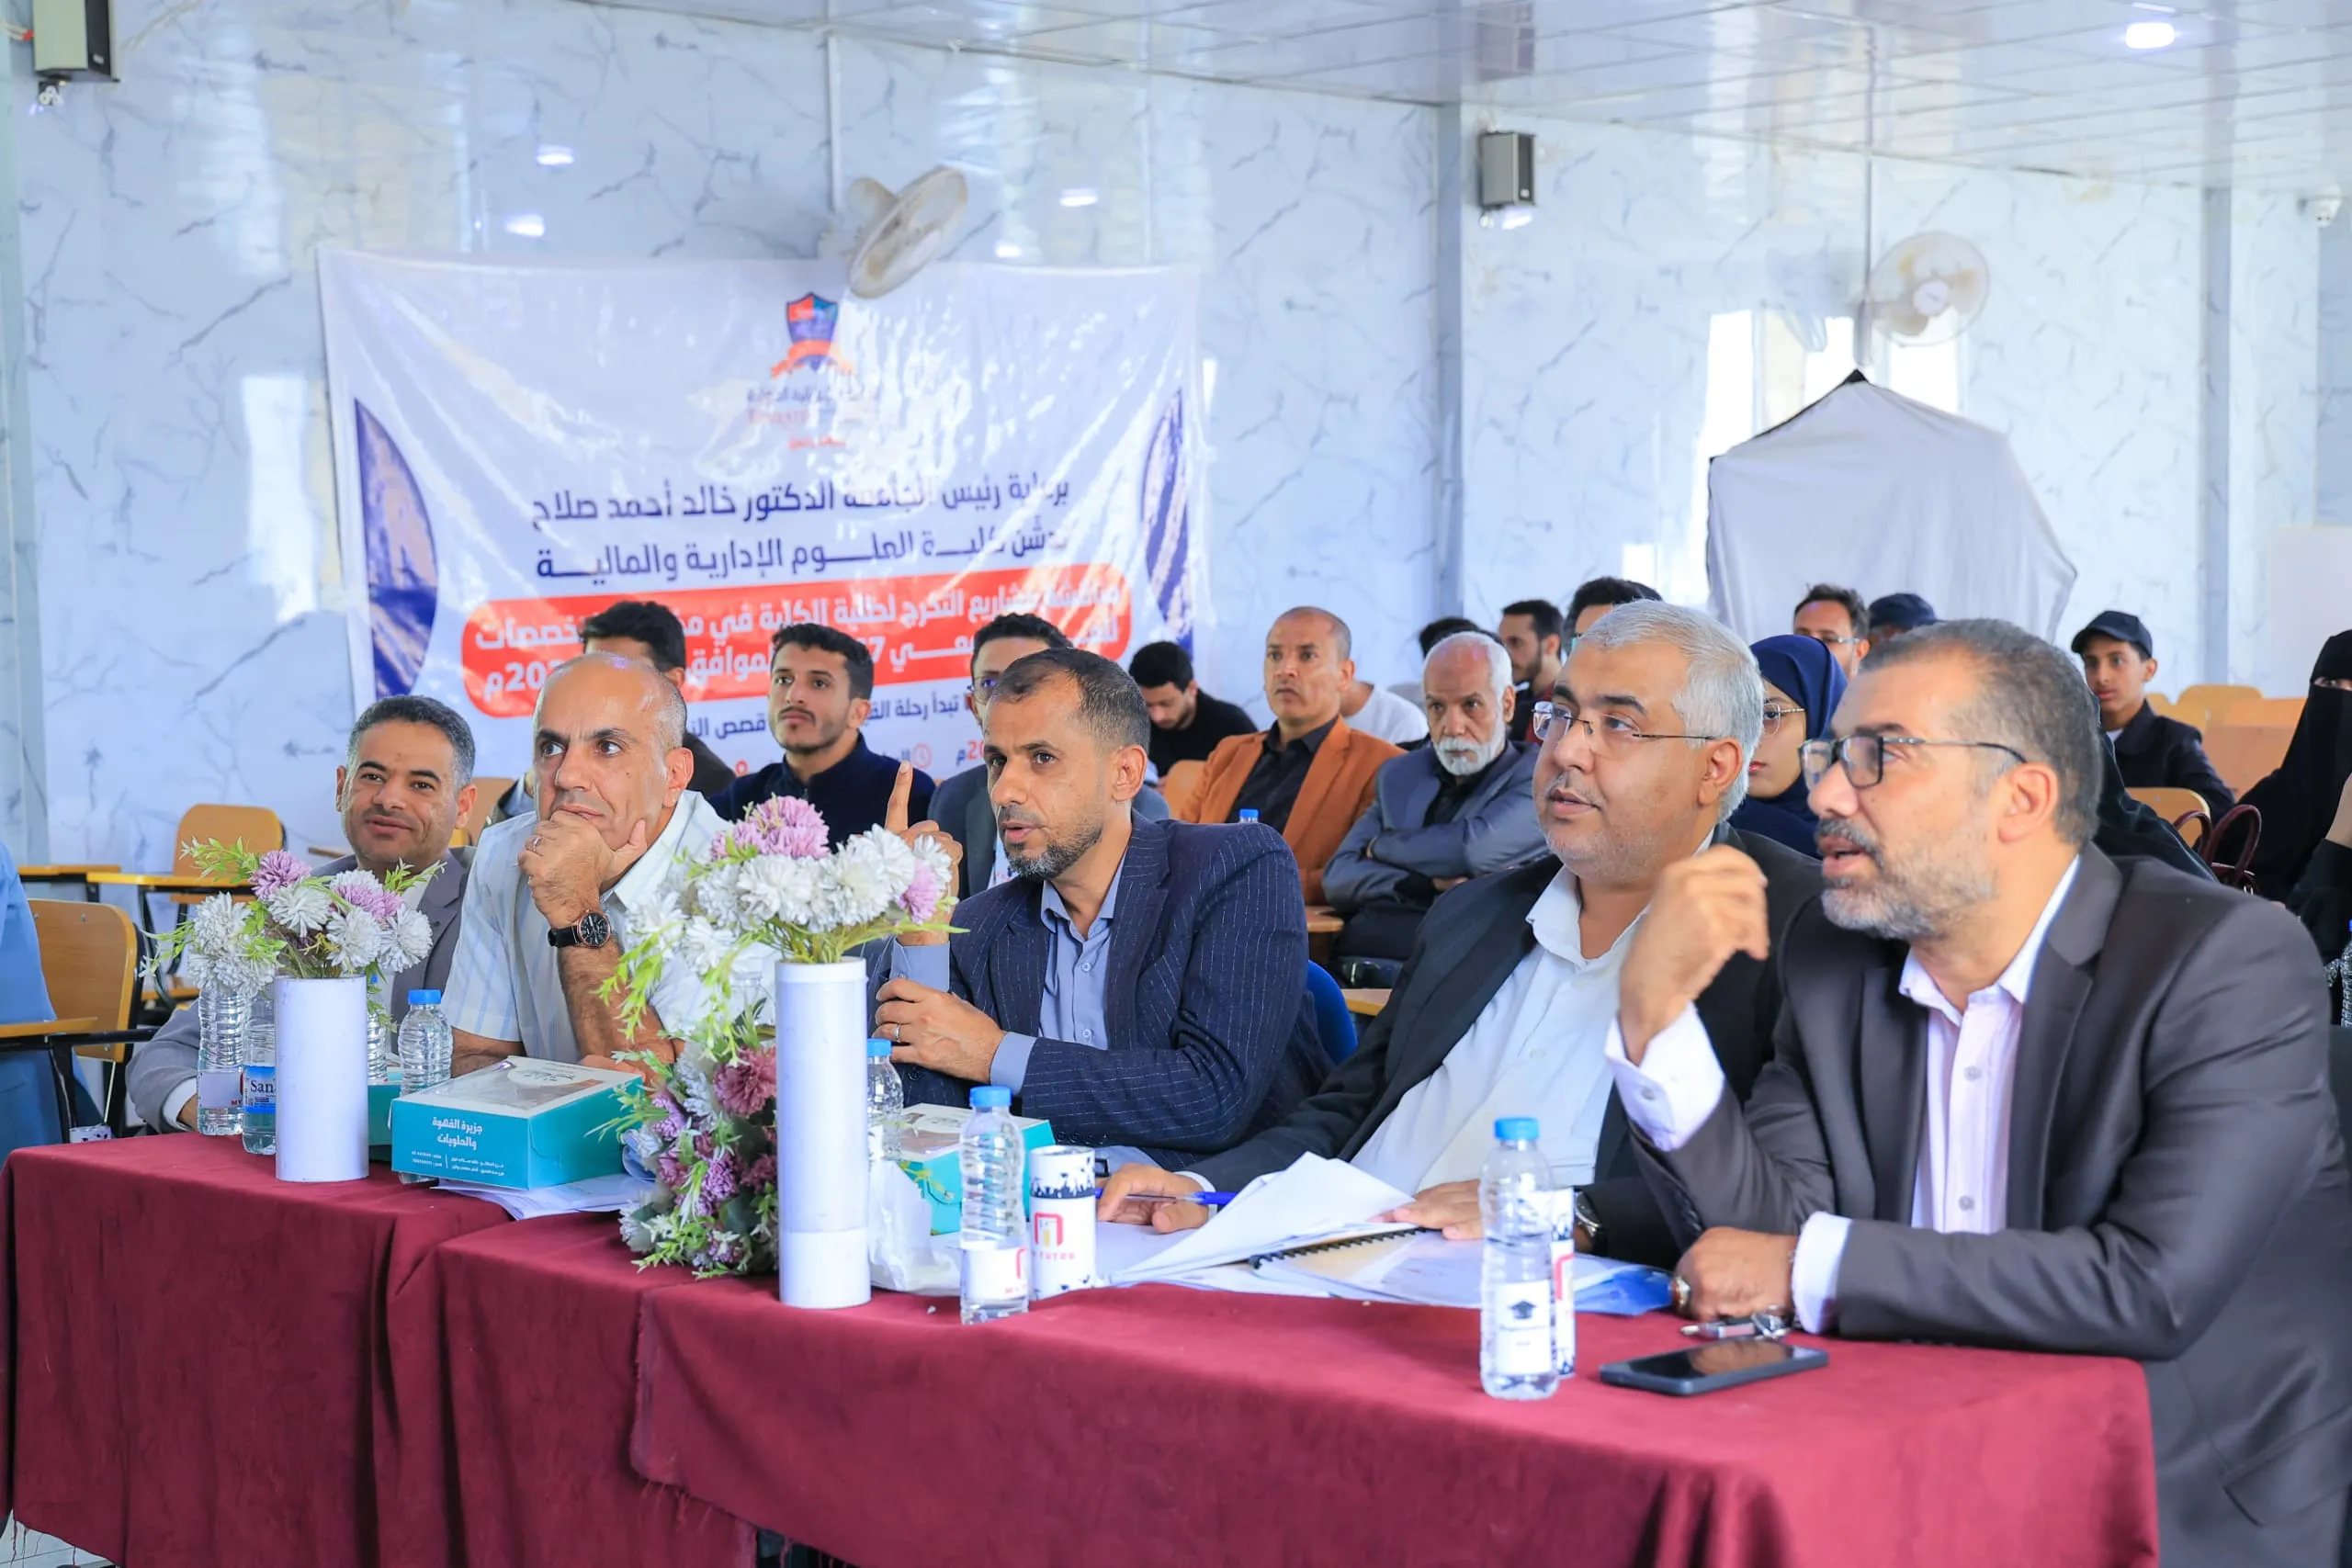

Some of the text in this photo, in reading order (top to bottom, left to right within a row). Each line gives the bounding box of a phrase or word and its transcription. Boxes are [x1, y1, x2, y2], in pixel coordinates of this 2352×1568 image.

[607, 478, 672, 518] أحمد
[683, 485, 736, 516] خالد
[742, 479, 834, 522] الدكتور
[941, 473, 1000, 511] رئيس
[1009, 471, 1069, 507] براية
[532, 490, 598, 531] صلاح
[537, 542, 677, 585] والمالية
[685, 538, 783, 578] الإدارية
[792, 529, 913, 574] العلوم
[708, 603, 754, 646] في
[833, 592, 897, 632] لطلبة
[899, 587, 965, 629] التخرج
[685, 643, 774, 689] لموافق
[715, 712, 766, 740] قصص
[895, 698, 929, 720] رحلة
[250, 1079, 276, 1093] San
[432, 1116, 460, 1130] القهوة
[436, 1134, 477, 1150] والحلويات
